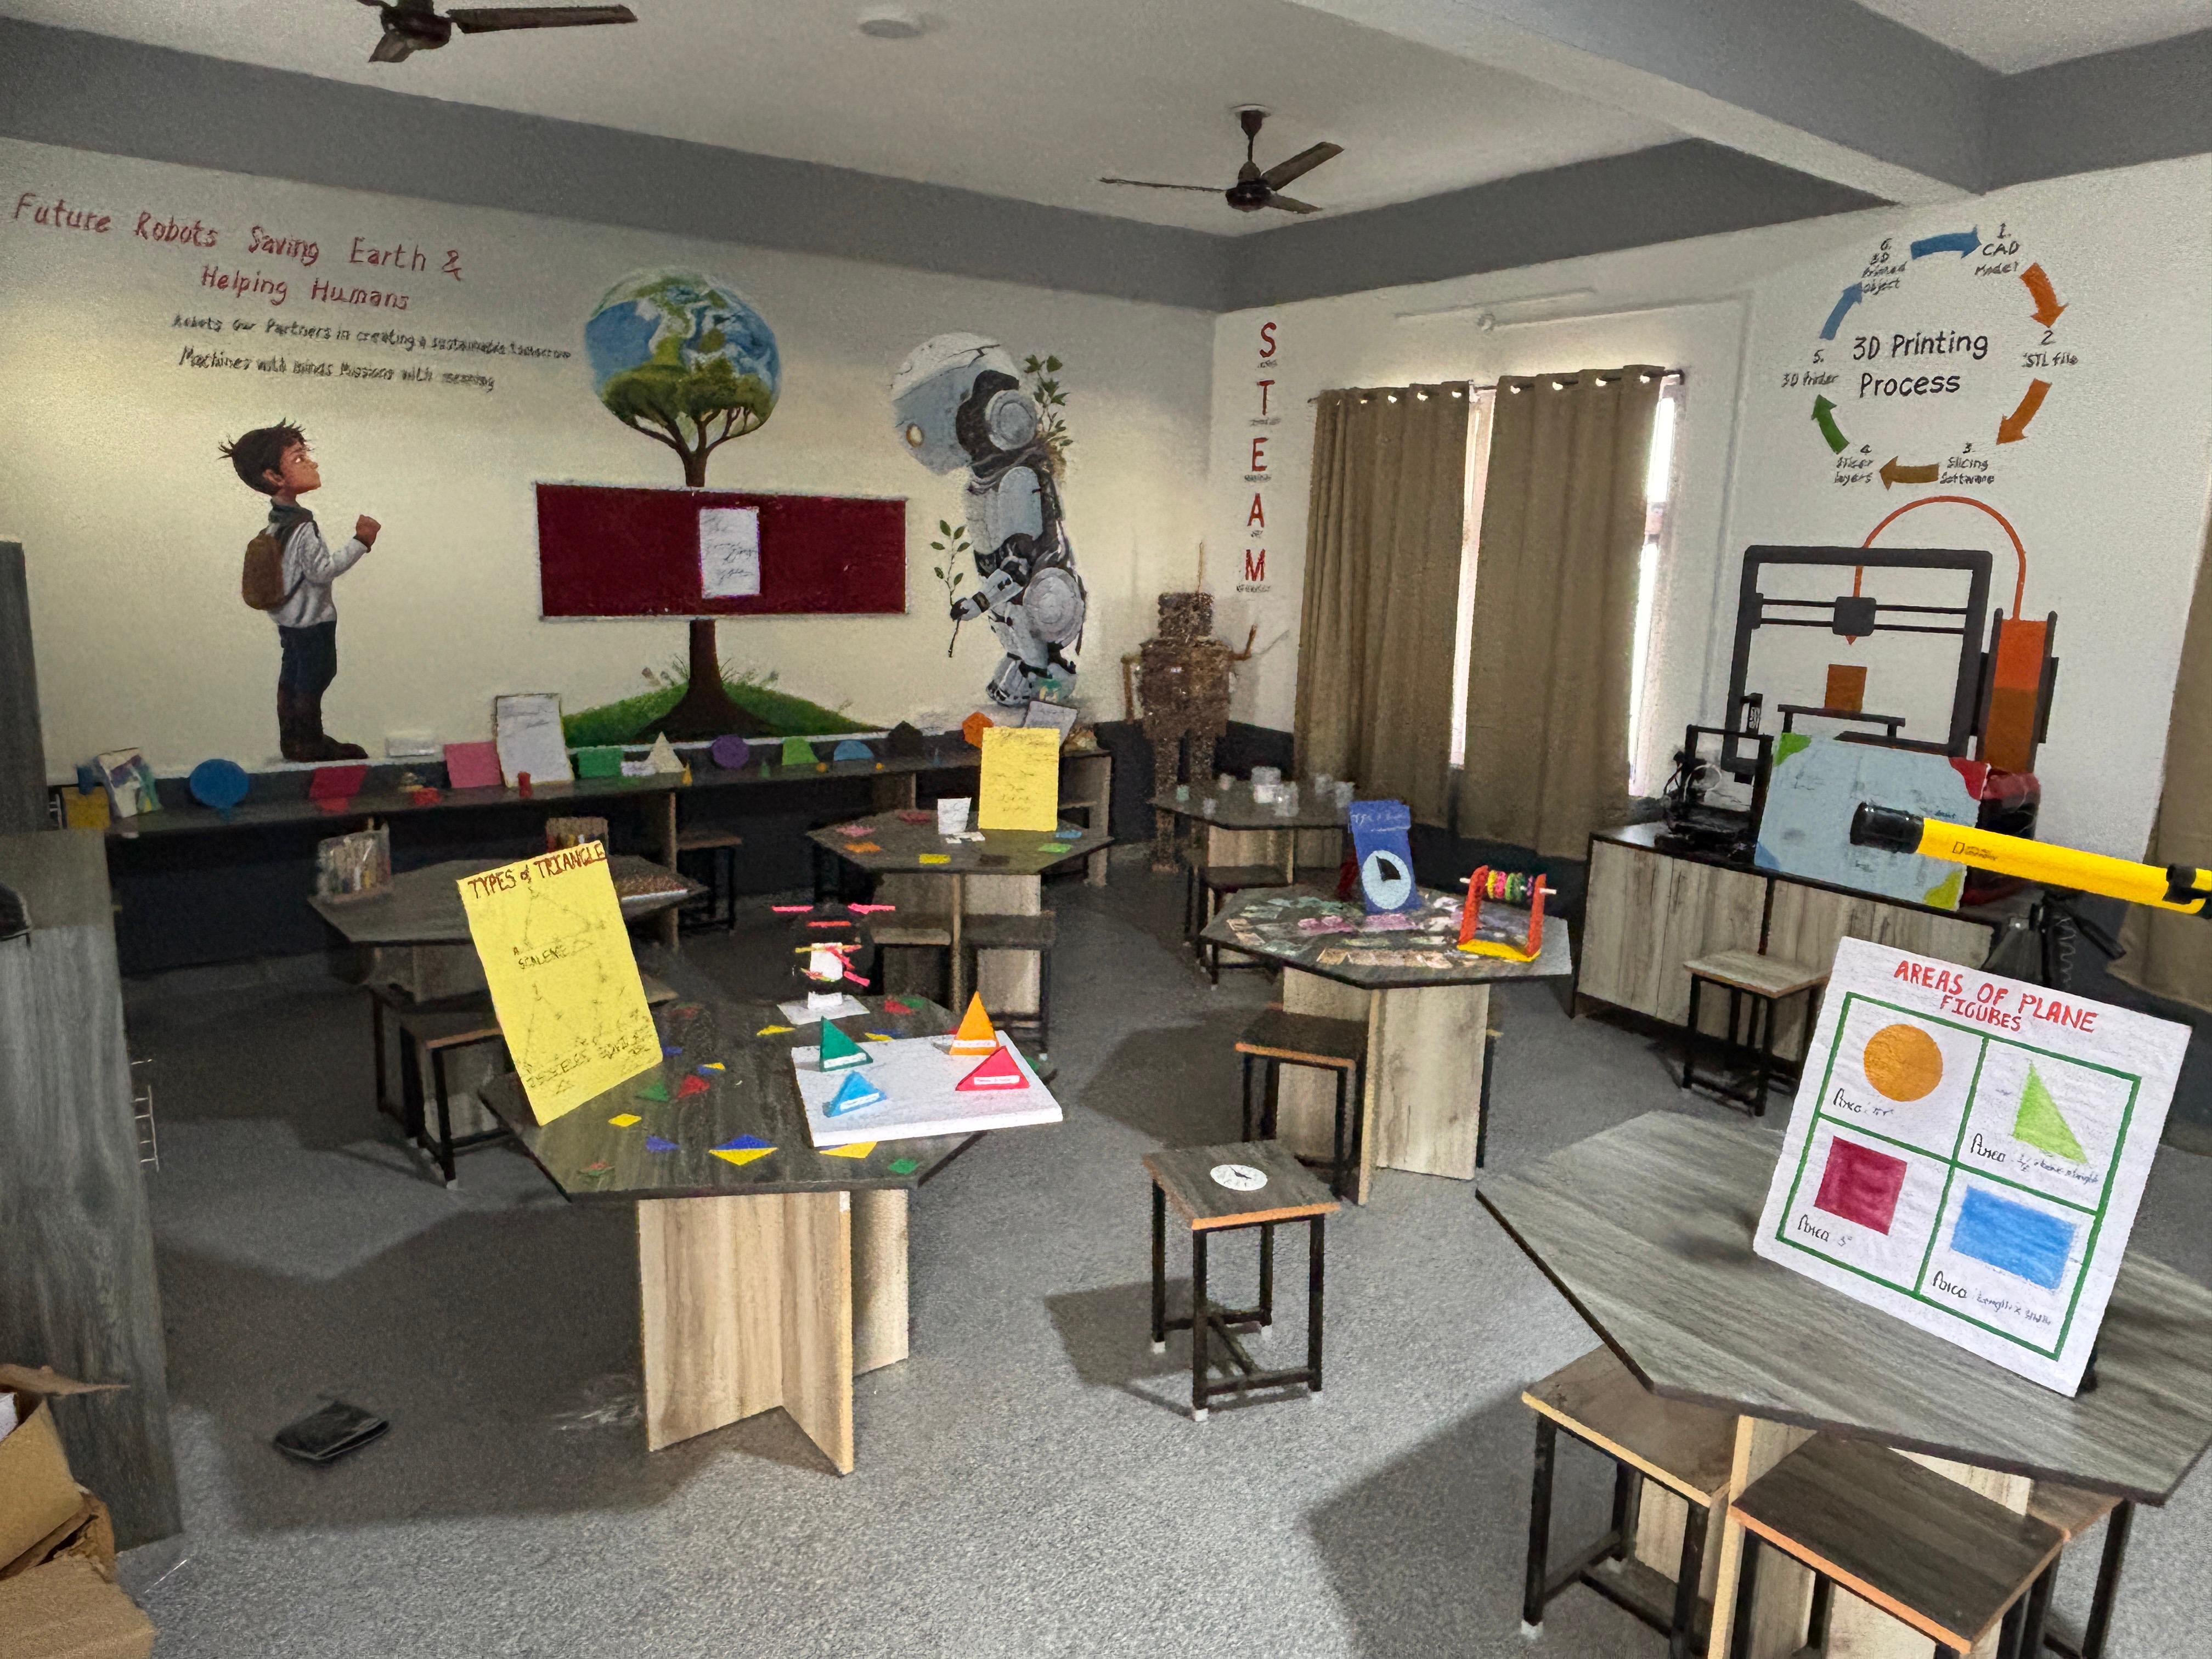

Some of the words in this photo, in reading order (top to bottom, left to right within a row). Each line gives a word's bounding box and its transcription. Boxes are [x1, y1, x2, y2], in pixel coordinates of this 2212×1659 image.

[14, 193, 111, 233] Future
[133, 210, 219, 248] Robots
[249, 225, 319, 266] Saving
[349, 236, 426, 272] Earth
[1982, 240, 2020, 256] CAD
[201, 265, 287, 306] Helping
[311, 278, 410, 310] Humans
[264, 317, 331, 340] Partners
[336, 327, 351, 341] in
[357, 329, 416, 352] creating
[1853, 335, 1881, 360] 3D
[1892, 329, 1988, 360] Printing
[2021, 352, 2050, 368] STL
[1859, 372, 1961, 399] Process
[1946, 456, 1989, 472] Slicing
[467, 869, 517, 899] TYPES
[1893, 960, 1964, 996] AREAS
[1977, 982, 2008, 1006] OF
[2018, 992, 2099, 1033] PLANE
[1939, 994, 2023, 1032] FIGURES
